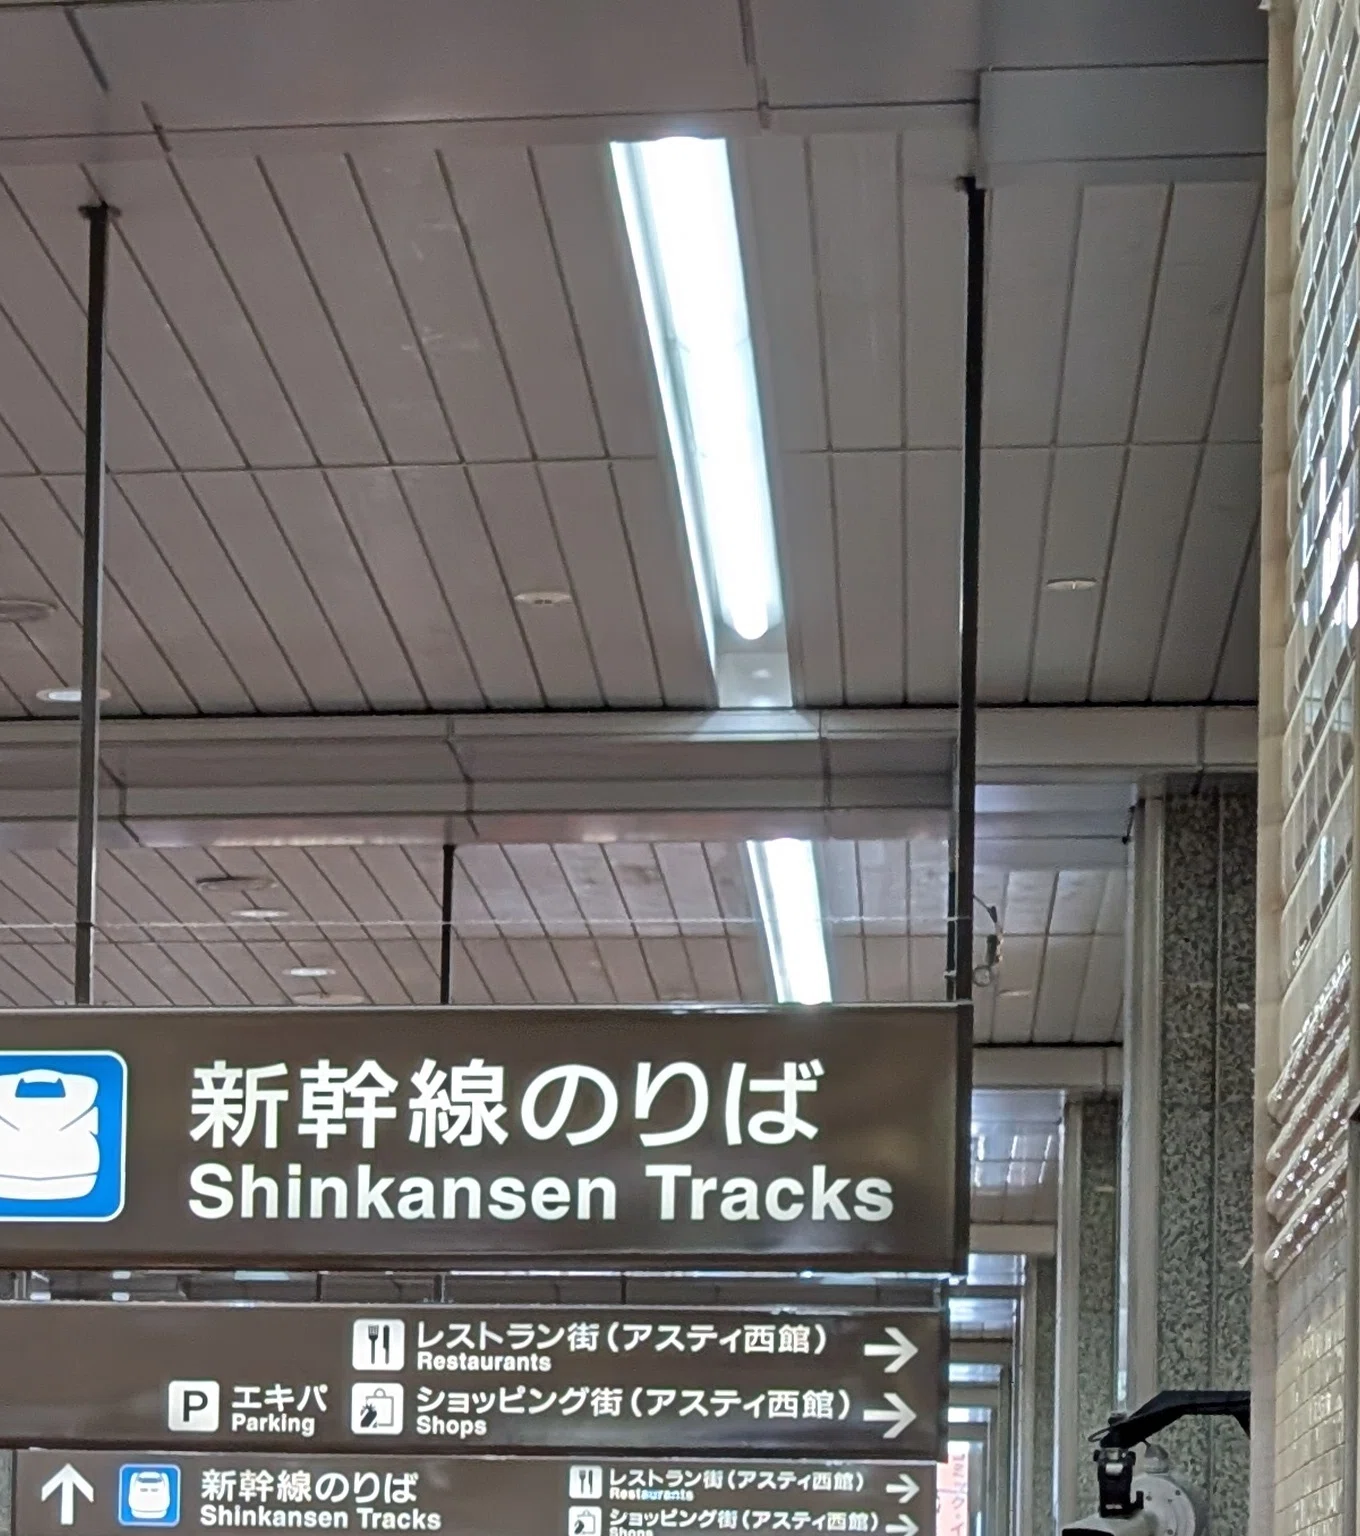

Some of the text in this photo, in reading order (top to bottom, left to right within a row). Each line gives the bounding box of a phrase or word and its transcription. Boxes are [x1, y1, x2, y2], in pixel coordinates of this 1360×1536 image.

[190, 1059, 824, 1148] 新幹線のりば
[189, 1163, 892, 1220] Shinkansen Tracks
[418, 1351, 551, 1371] Restaurants
[232, 1413, 314, 1437] Parking
[417, 1415, 486, 1438] Shops
[202, 1469, 418, 1503] 新幹線のりば
[200, 1504, 441, 1529] Shinkansen Tracks
